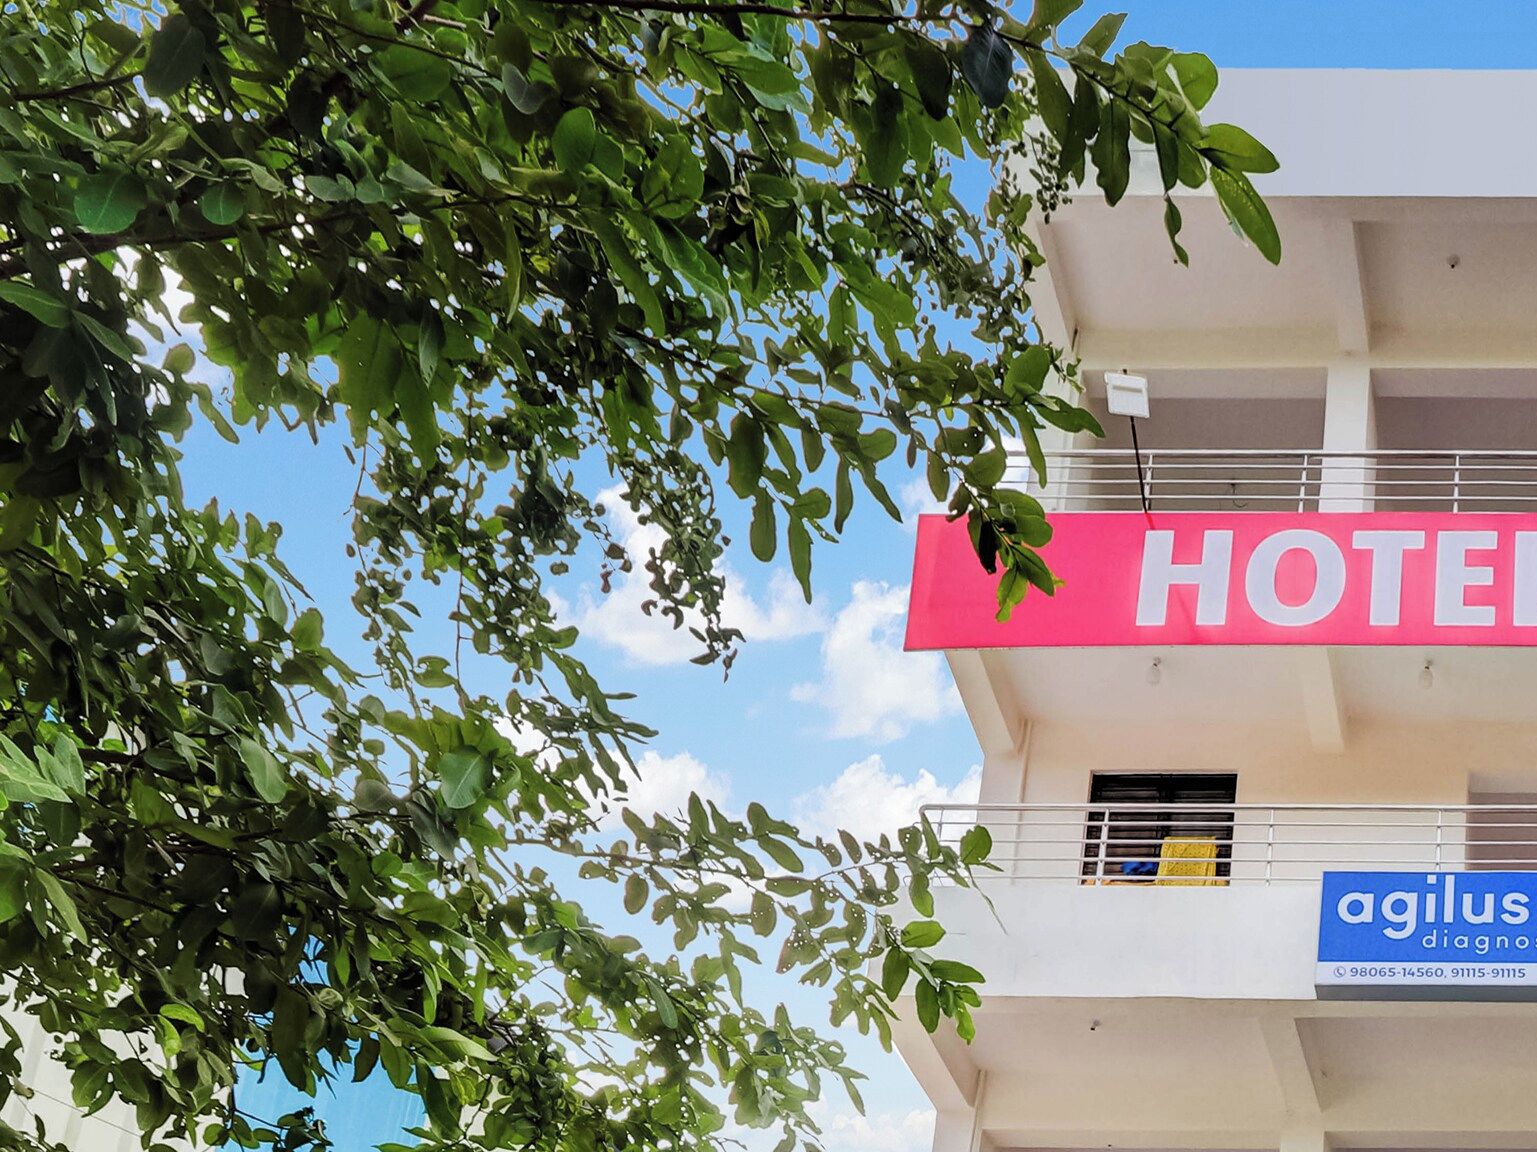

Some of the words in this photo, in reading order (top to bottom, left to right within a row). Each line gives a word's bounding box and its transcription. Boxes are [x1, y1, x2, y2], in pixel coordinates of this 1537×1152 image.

[1336, 874, 1531, 940] agilus
[1349, 966, 1448, 979] 98065-14560,
[1451, 967, 1527, 979] 91115-91115
